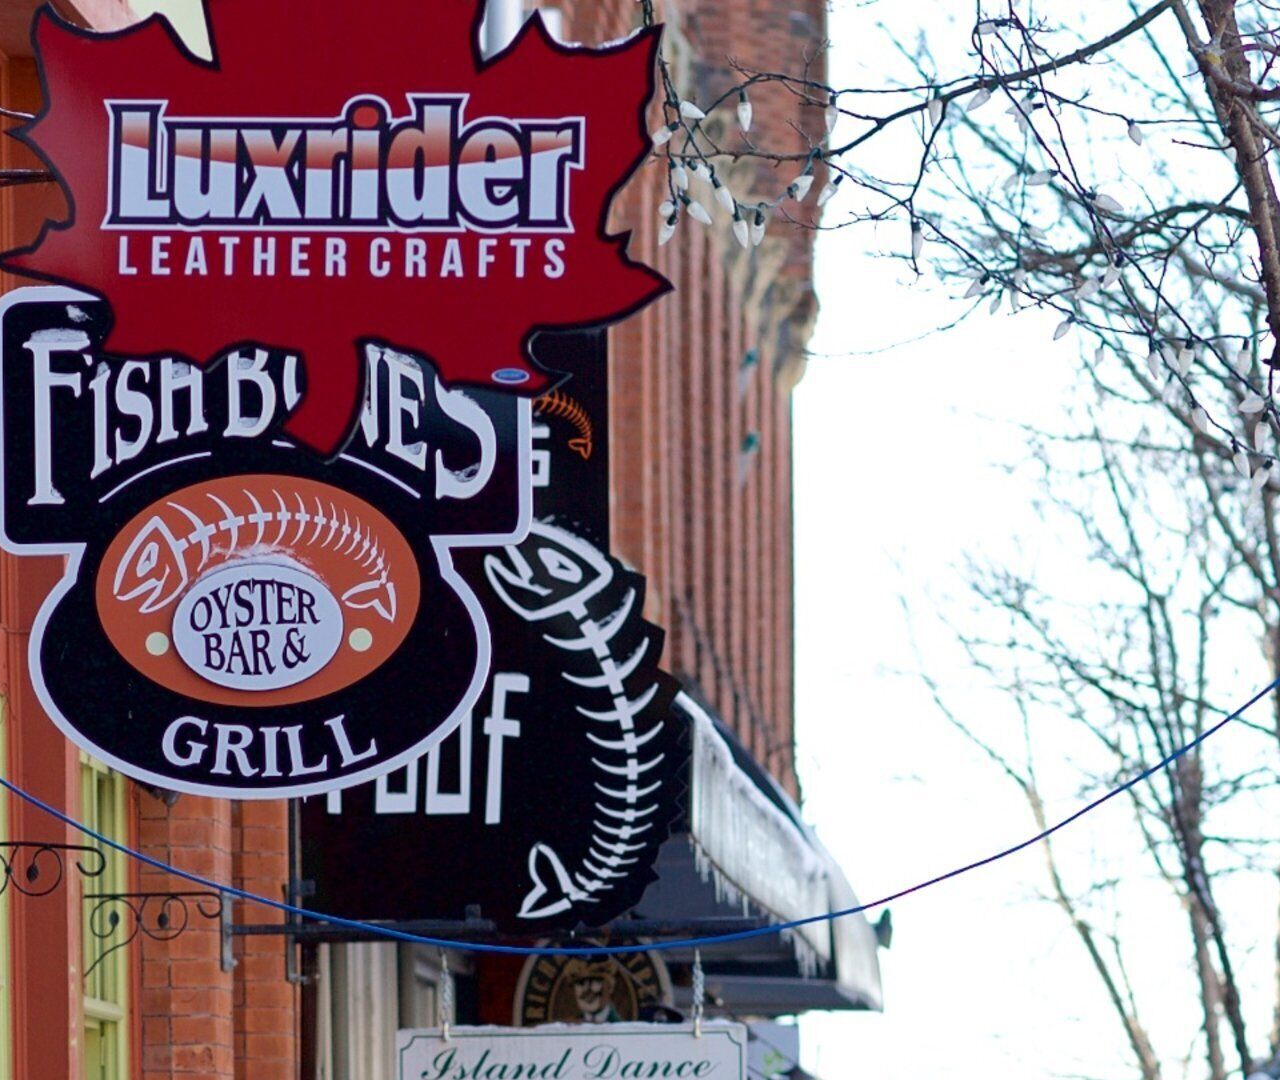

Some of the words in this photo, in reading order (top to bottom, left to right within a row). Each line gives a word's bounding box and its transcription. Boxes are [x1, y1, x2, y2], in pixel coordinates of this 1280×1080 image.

[103, 94, 583, 232] Luxrider
[119, 236, 347, 275] LEATHER
[369, 237, 565, 278] CRAFTS
[189, 578, 321, 632] OYSTER
[202, 629, 276, 675] BAR
[282, 627, 312, 669] &
[161, 714, 379, 777] GRILL
[582, 1044, 720, 1080] Dance
